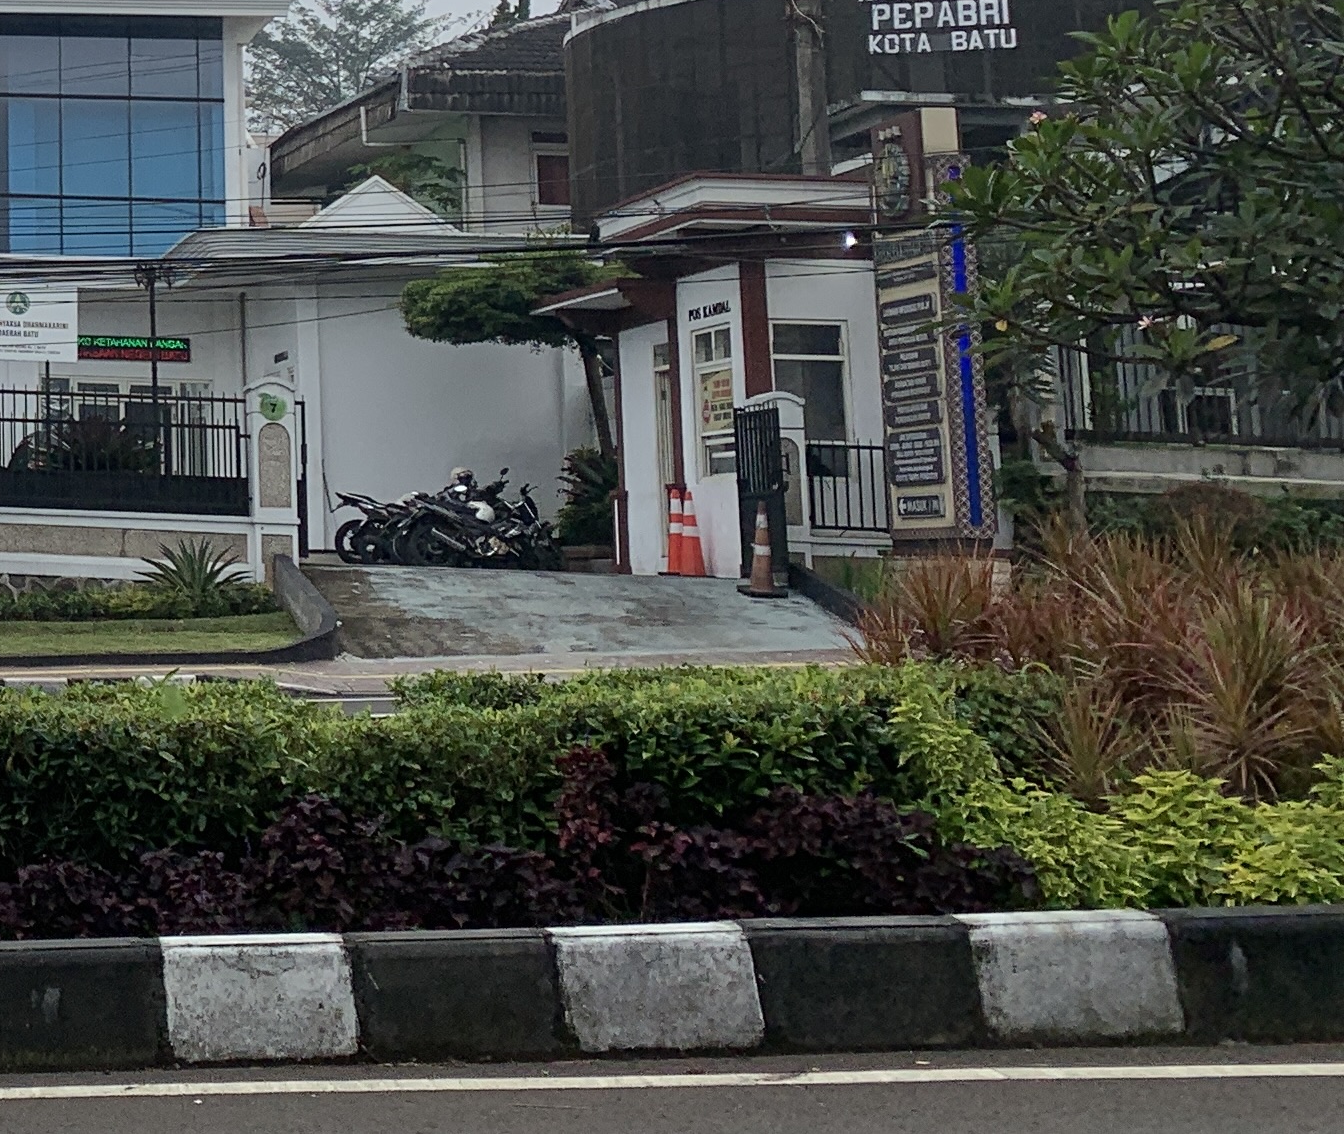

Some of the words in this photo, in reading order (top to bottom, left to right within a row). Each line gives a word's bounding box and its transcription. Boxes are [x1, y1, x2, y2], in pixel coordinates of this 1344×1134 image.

[868, 32, 932, 55] KOTA
[950, 28, 1018, 52] BATU
[688, 306, 701, 321] POS
[93, 338, 148, 348] KETAHANAN
[269, 402, 277, 413] 7
